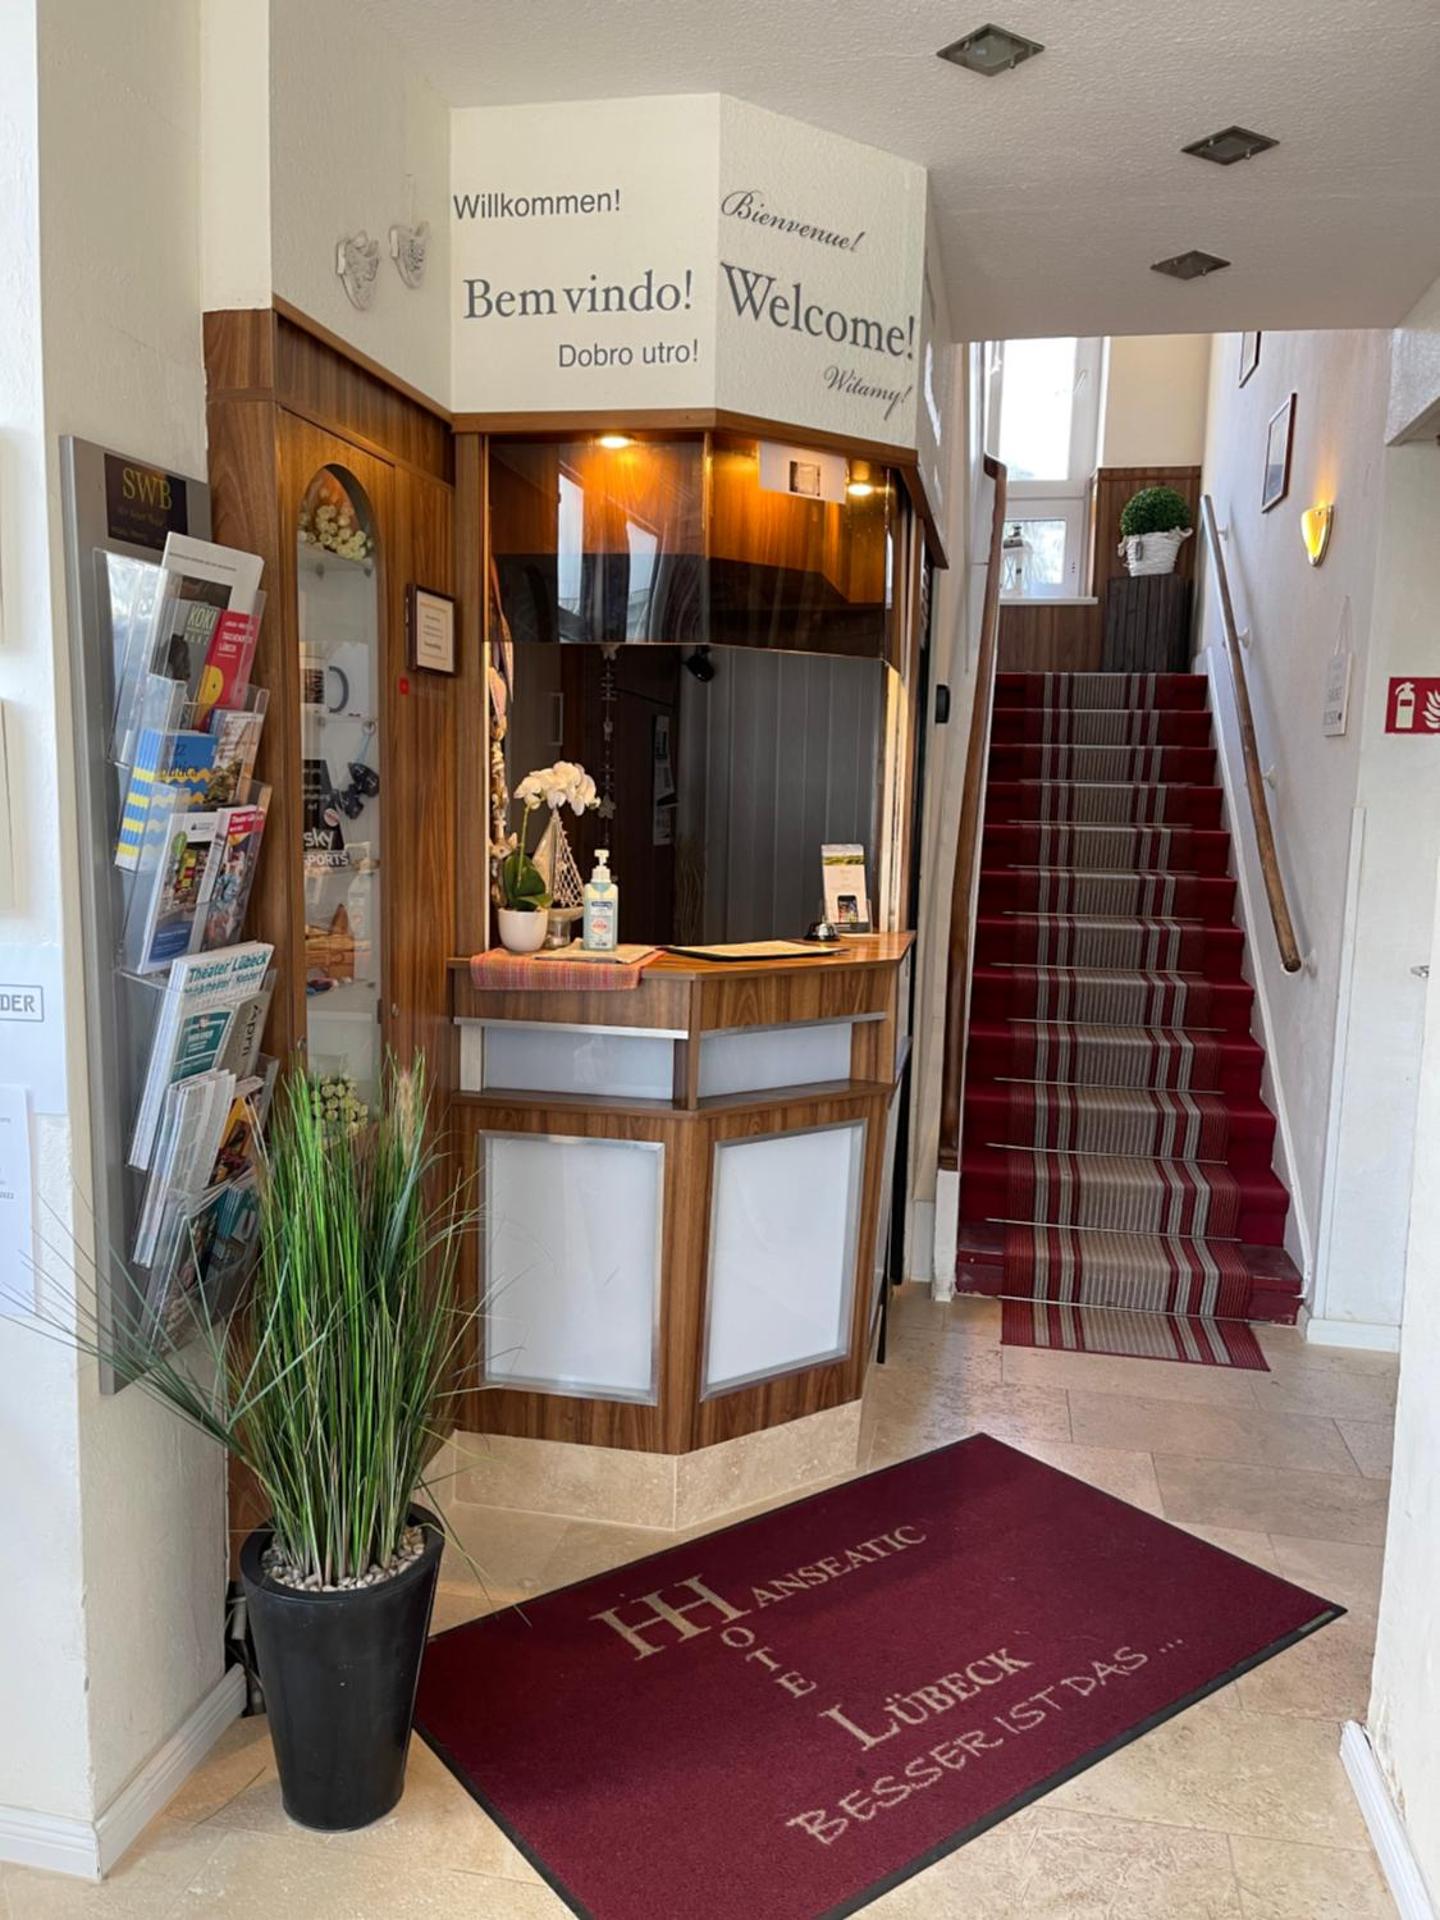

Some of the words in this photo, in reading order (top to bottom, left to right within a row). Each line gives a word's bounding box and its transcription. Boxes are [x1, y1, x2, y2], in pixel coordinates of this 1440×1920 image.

[453, 188, 620, 220] Willkommen!
[721, 190, 866, 252] Bienvenue!
[463, 278, 558, 319] Bem
[563, 269, 693, 314] vindo!
[720, 262, 915, 360] Welcome!
[559, 343, 633, 368] Dobro
[642, 339, 699, 364] utro!
[824, 365, 913, 421] Witamy!
[123, 467, 172, 510] SWB
[303, 827, 334, 850] sky
[819, 1648, 1033, 1752] LÜBECK
[787, 1729, 1005, 1846] BESSER
[994, 1686, 1064, 1735] IST
[1060, 1646, 1148, 1697] DAS
